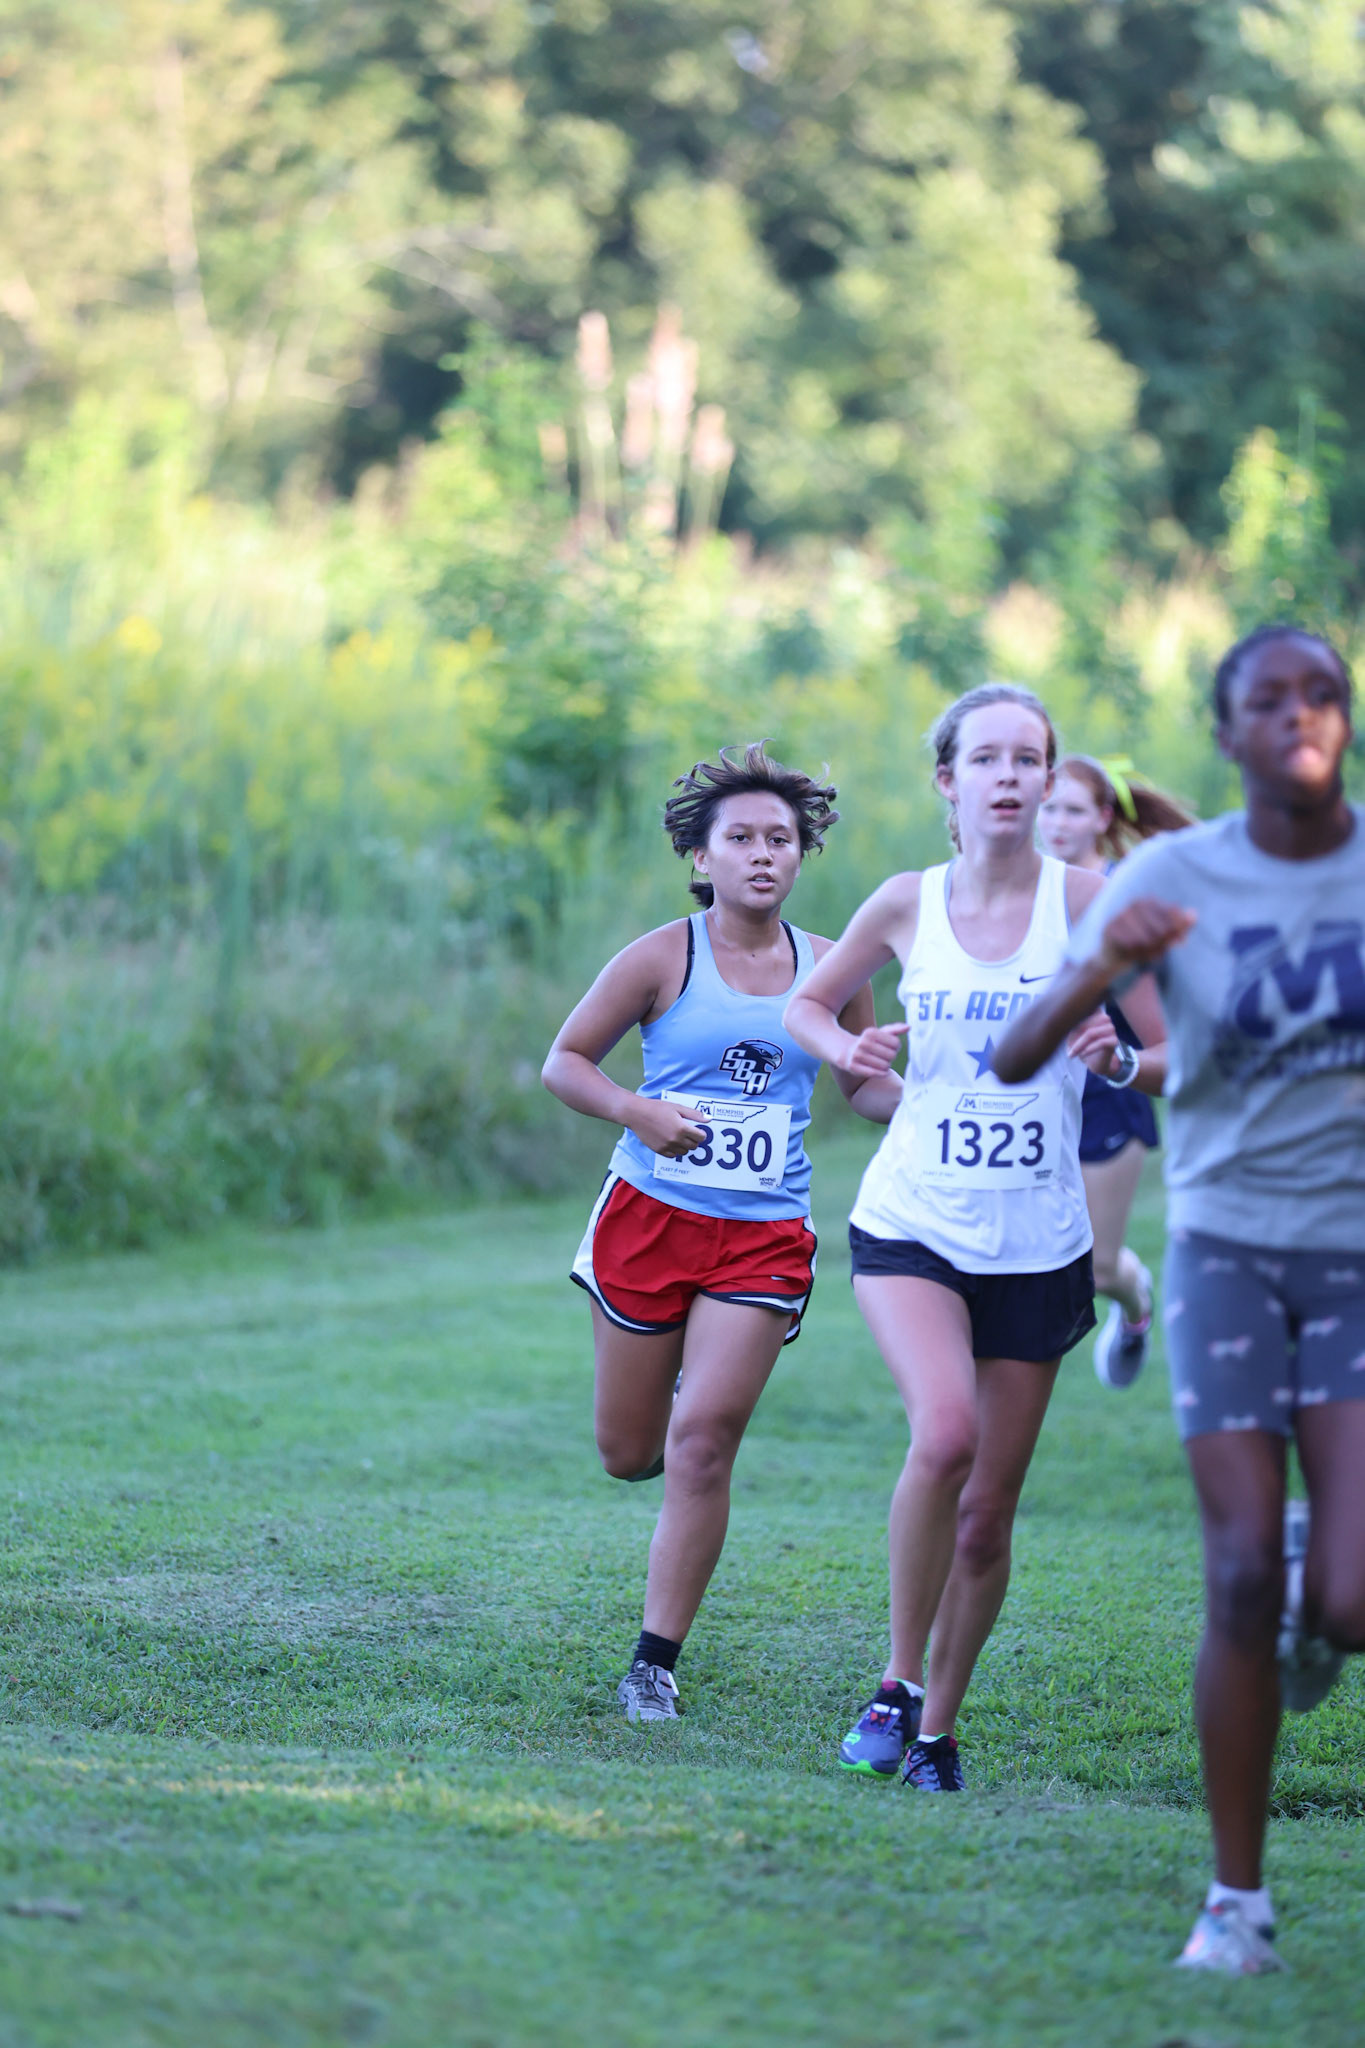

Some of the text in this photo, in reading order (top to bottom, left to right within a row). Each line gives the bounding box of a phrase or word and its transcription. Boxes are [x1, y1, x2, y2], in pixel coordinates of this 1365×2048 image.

[918, 990, 954, 1021] ST.
[720, 1048, 769, 1095] SBA
[716, 1107, 745, 1116] MEMPHIS
[675, 1124, 773, 1173] 330
[937, 1118, 1045, 1168] 1323
